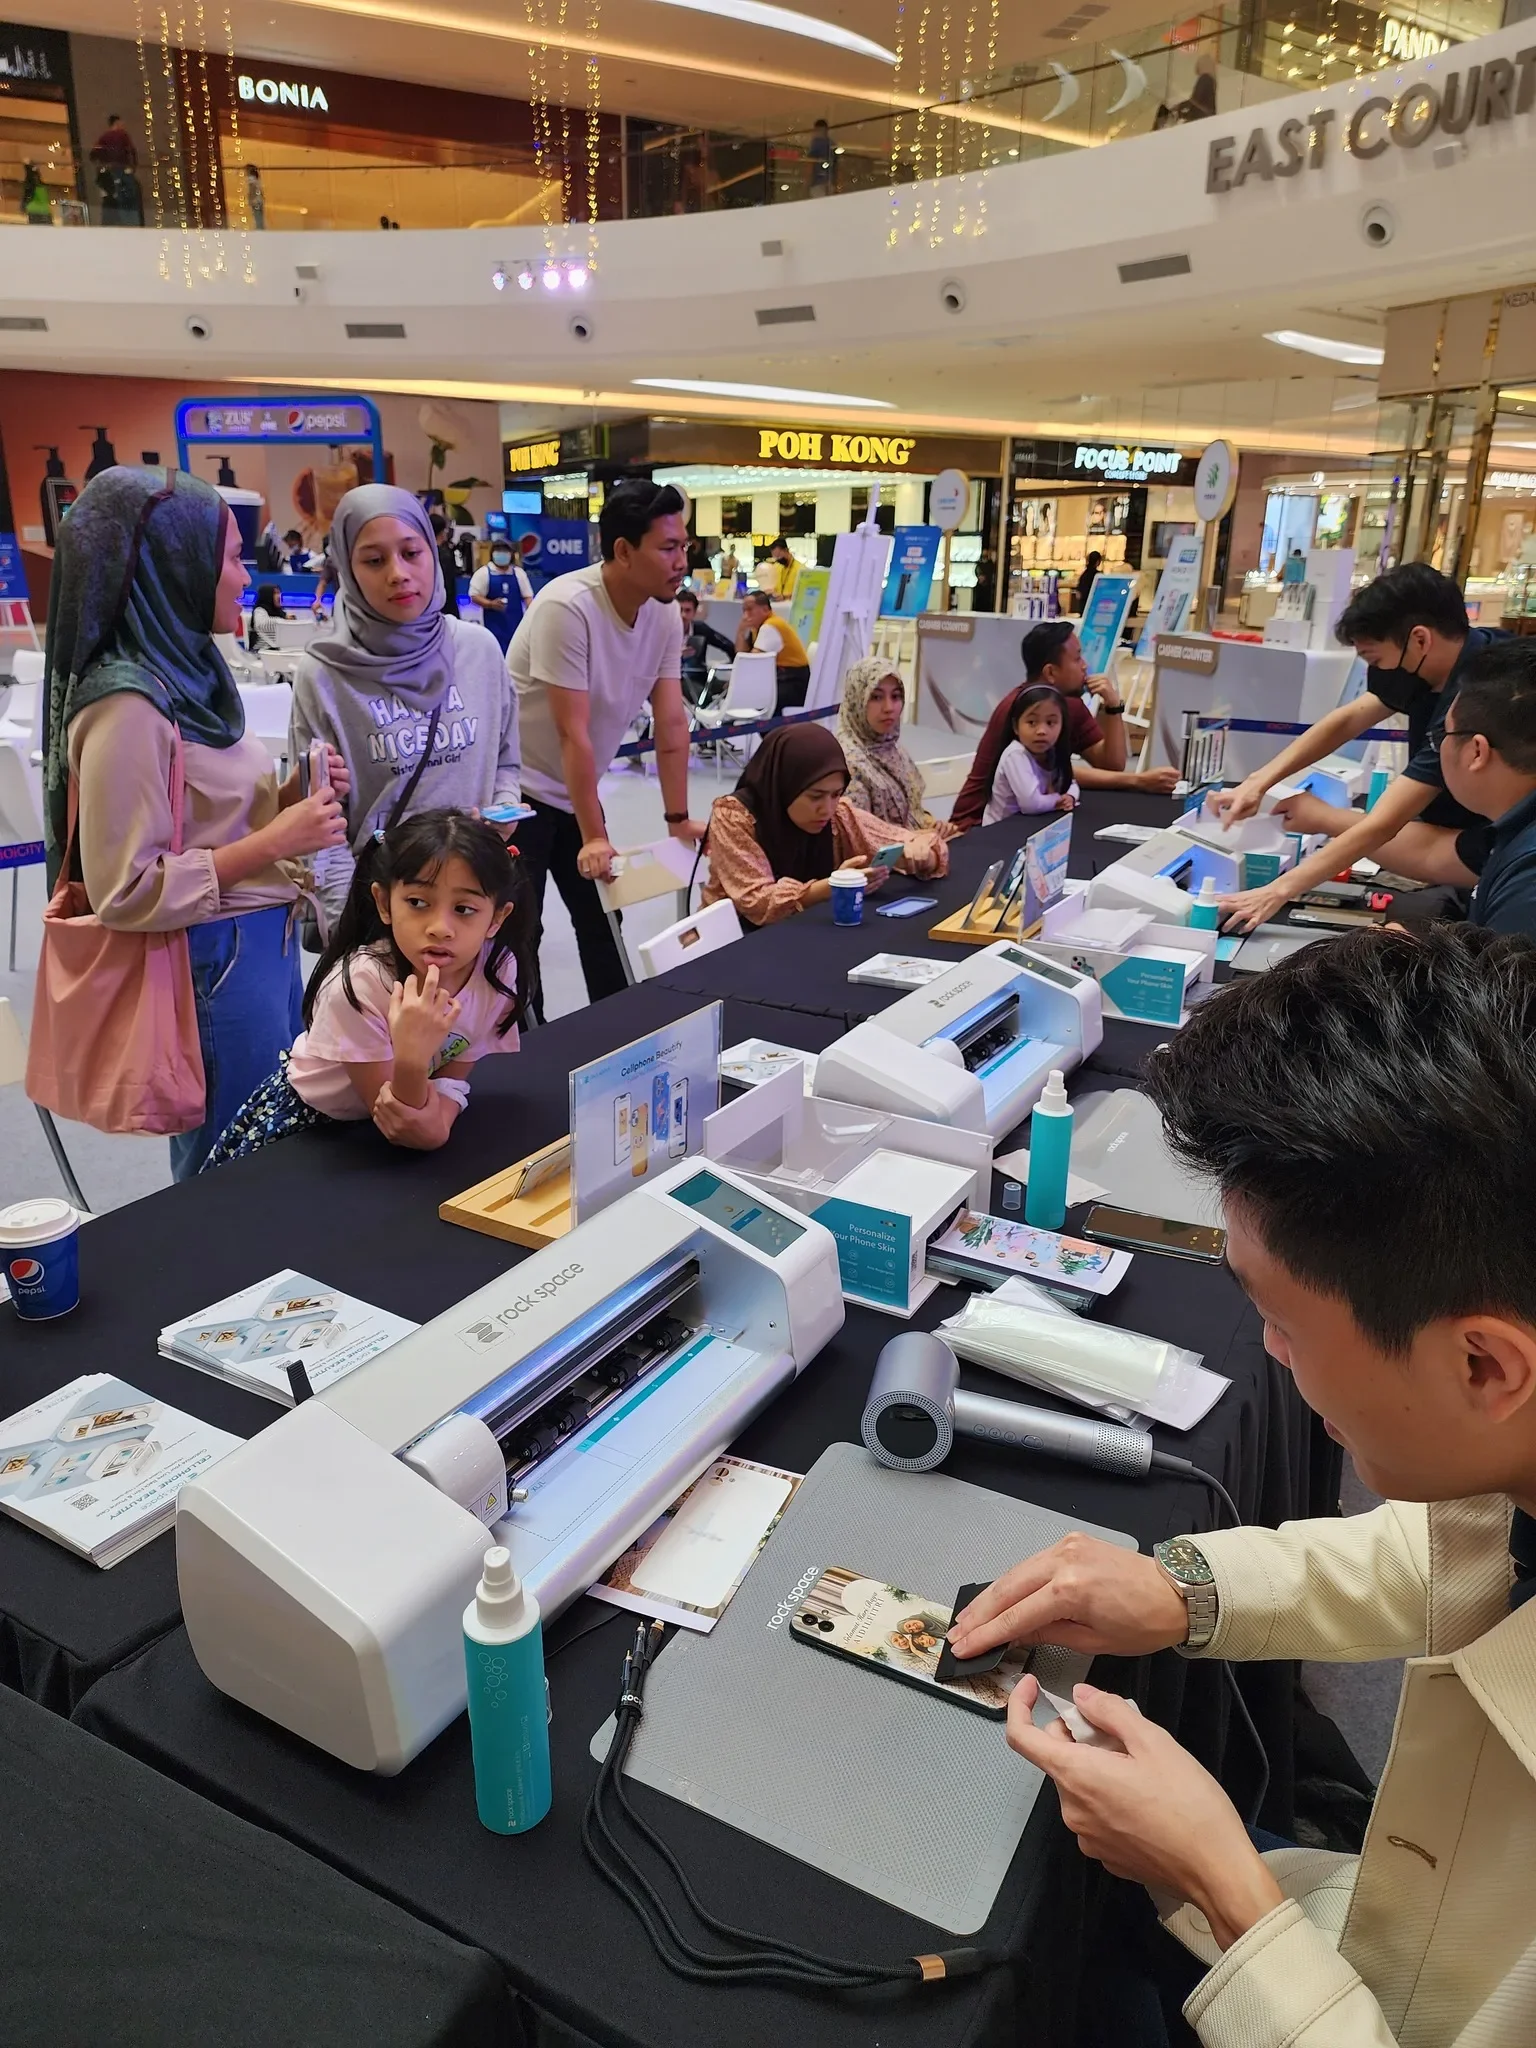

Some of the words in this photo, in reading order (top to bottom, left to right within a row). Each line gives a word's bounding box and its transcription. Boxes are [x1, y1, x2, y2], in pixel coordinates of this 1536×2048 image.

[238, 75, 329, 112] BONIA
[1206, 108, 1335, 194] EAST
[306, 411, 347, 431] pepsi
[758, 430, 824, 461] POH
[830, 434, 911, 465] KONG
[1074, 446, 1130, 471] FOCUS
[1132, 450, 1183, 474] POINT
[547, 539, 584, 555] ONE
[1182, 647, 1213, 664] COUNTER
[445, 684, 464, 713] A
[367, 724, 429, 764] NICE
[432, 716, 479, 753] DAY
[620, 1053, 655, 1077] Cellphone
[655, 1040, 683, 1060] Beautify
[849, 1223, 896, 1243] Personalize
[849, 1235, 876, 1249] Phone
[877, 1242, 896, 1254] Skin
[18, 1285, 47, 1296] pepsi
[495, 1294, 541, 1326] rock
[533, 1263, 585, 1299] space
[347, 1334, 389, 1359] CELLPHONE
[157, 1454, 212, 1489] CELLPHONE
[109, 1489, 157, 1520] BEAUTIFY
[140, 1492, 168, 1510] space
[766, 1598, 795, 1630] rock
[787, 1566, 819, 1602] space
[843, 1621, 860, 1645] Selamat
